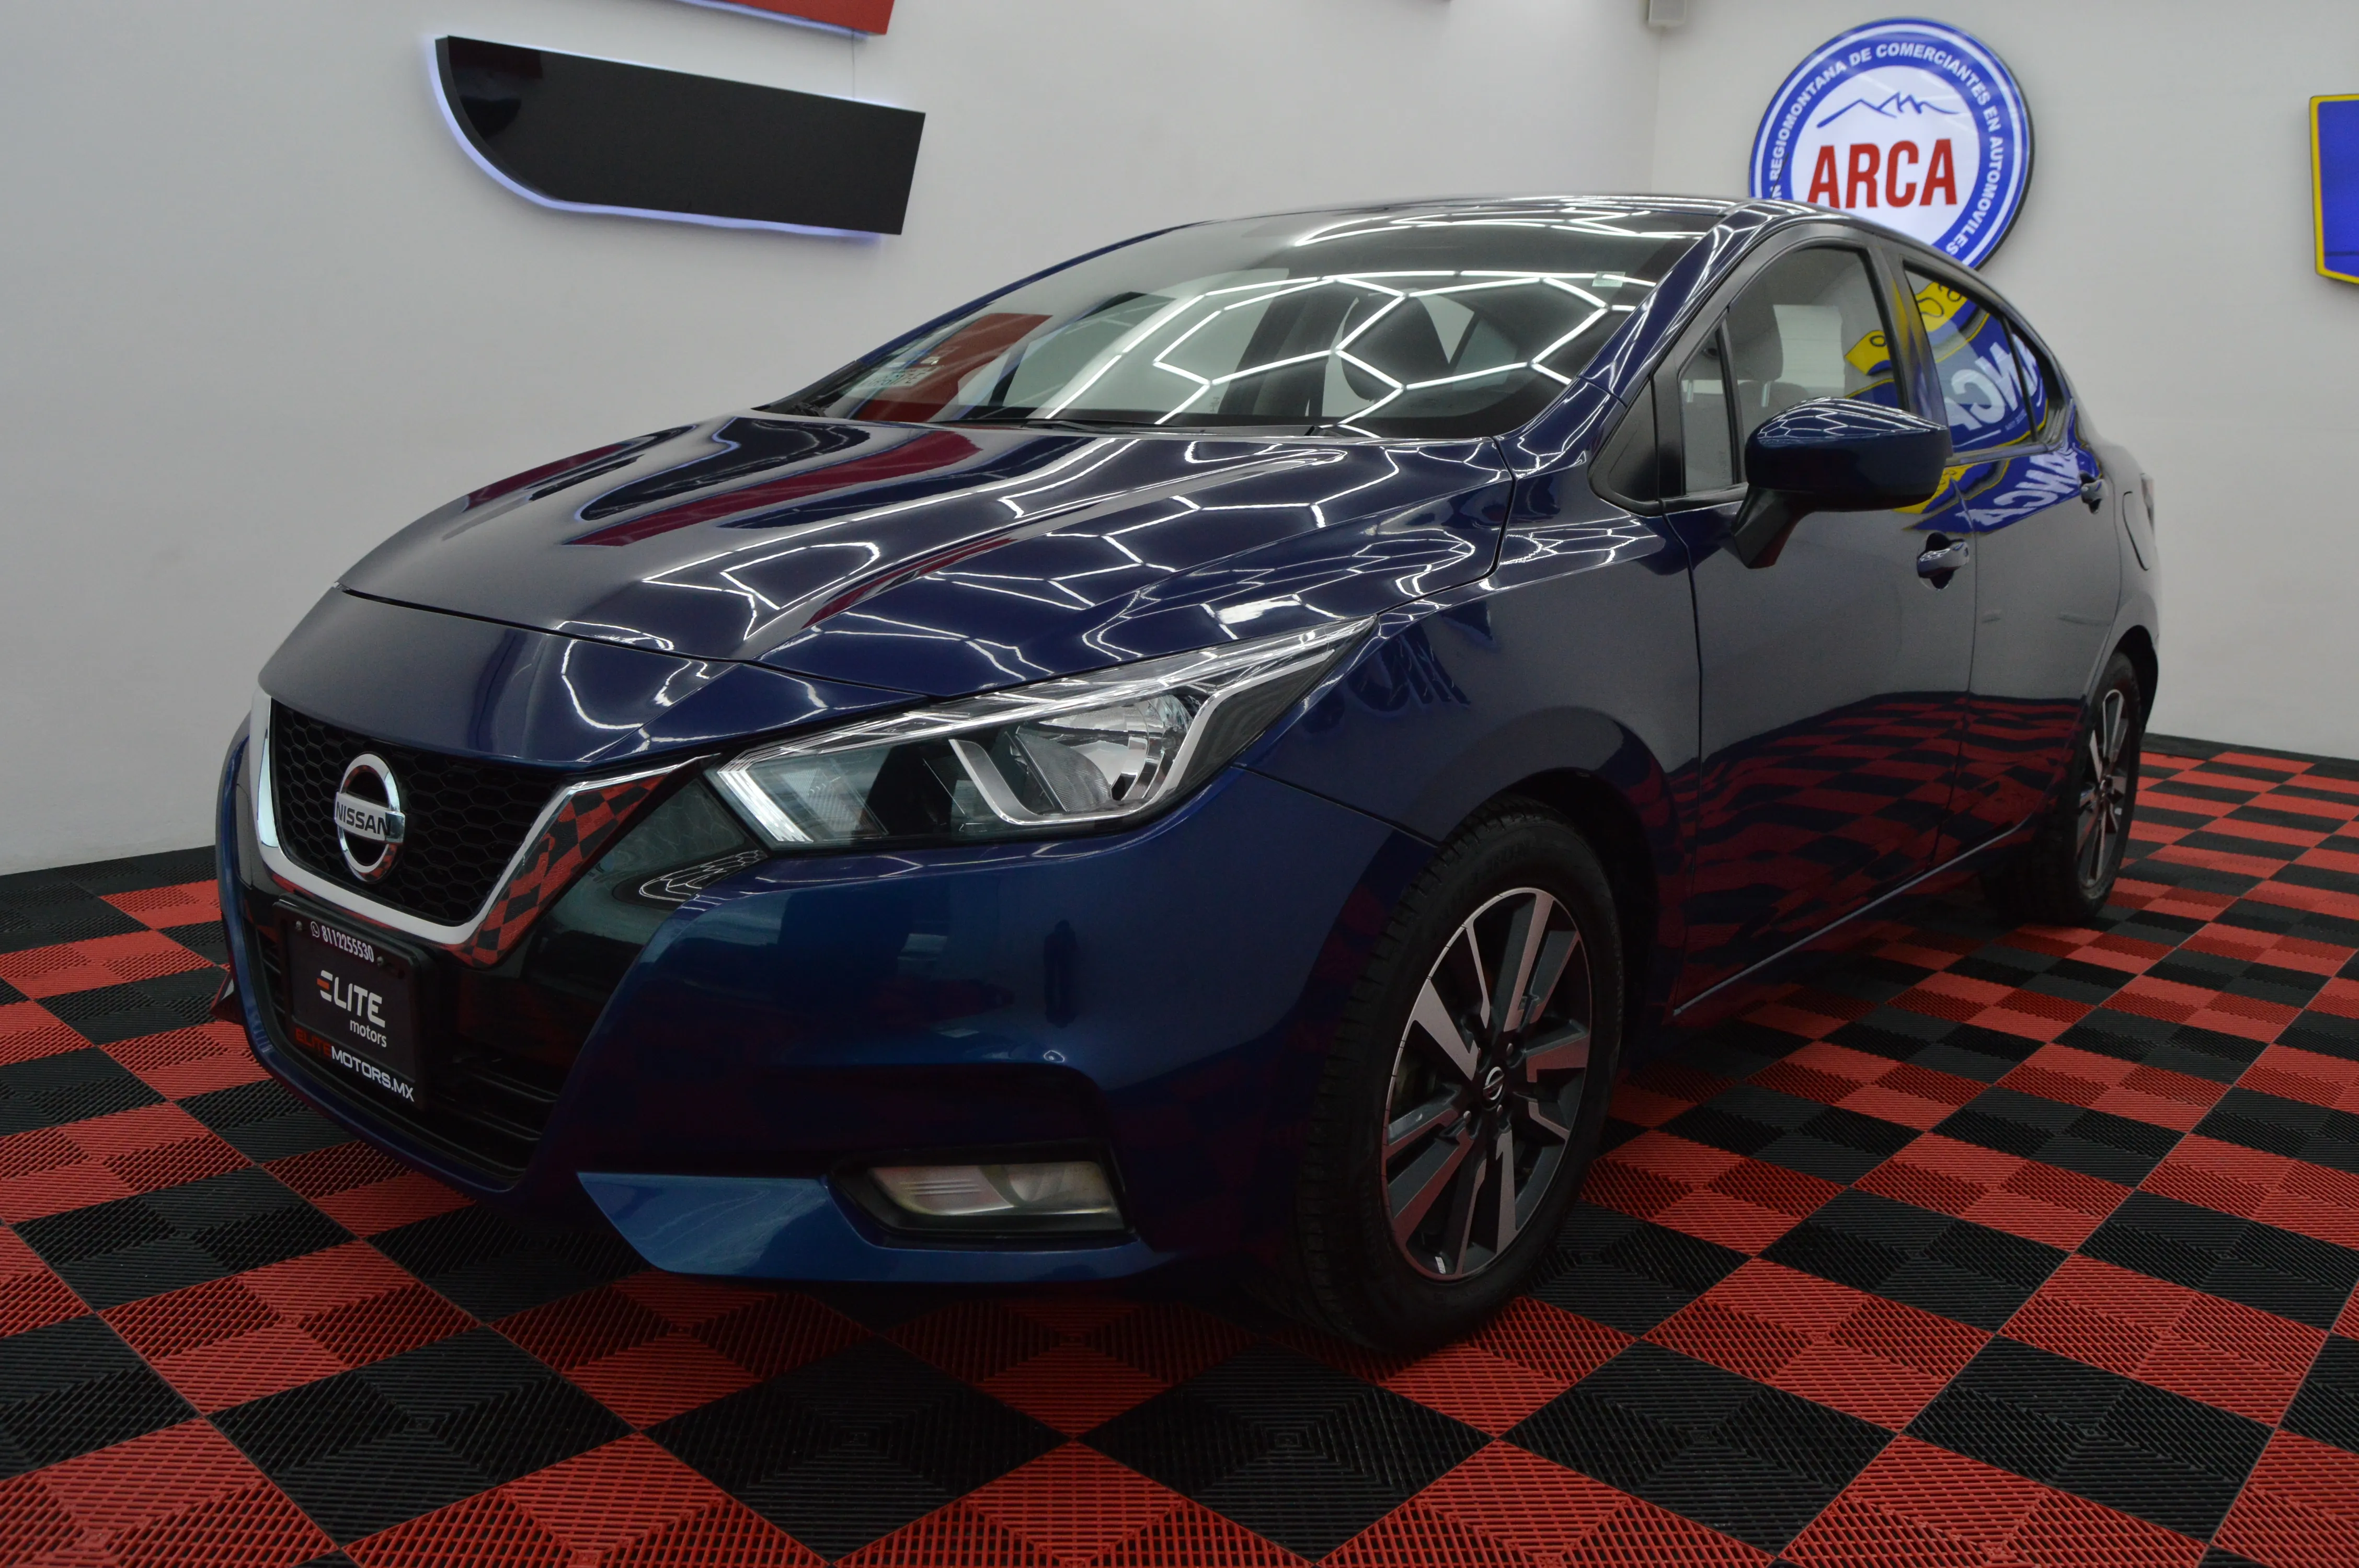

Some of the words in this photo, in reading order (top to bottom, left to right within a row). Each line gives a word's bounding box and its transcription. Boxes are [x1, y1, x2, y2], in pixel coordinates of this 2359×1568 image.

[1849, 48, 1872, 67] DE
[1876, 42, 1991, 106] COMERCIANTES
[1770, 61, 1847, 182] REGIOMONTANA
[1983, 106, 2001, 132] EN
[1807, 139, 1957, 209] ARCA
[1945, 136, 2003, 255] AUTOMOVILES
[336, 801, 392, 836] NISSAN
[322, 925, 374, 963] 8112255530
[317, 970, 385, 1028] ELITE
[350, 1020, 387, 1047] motors
